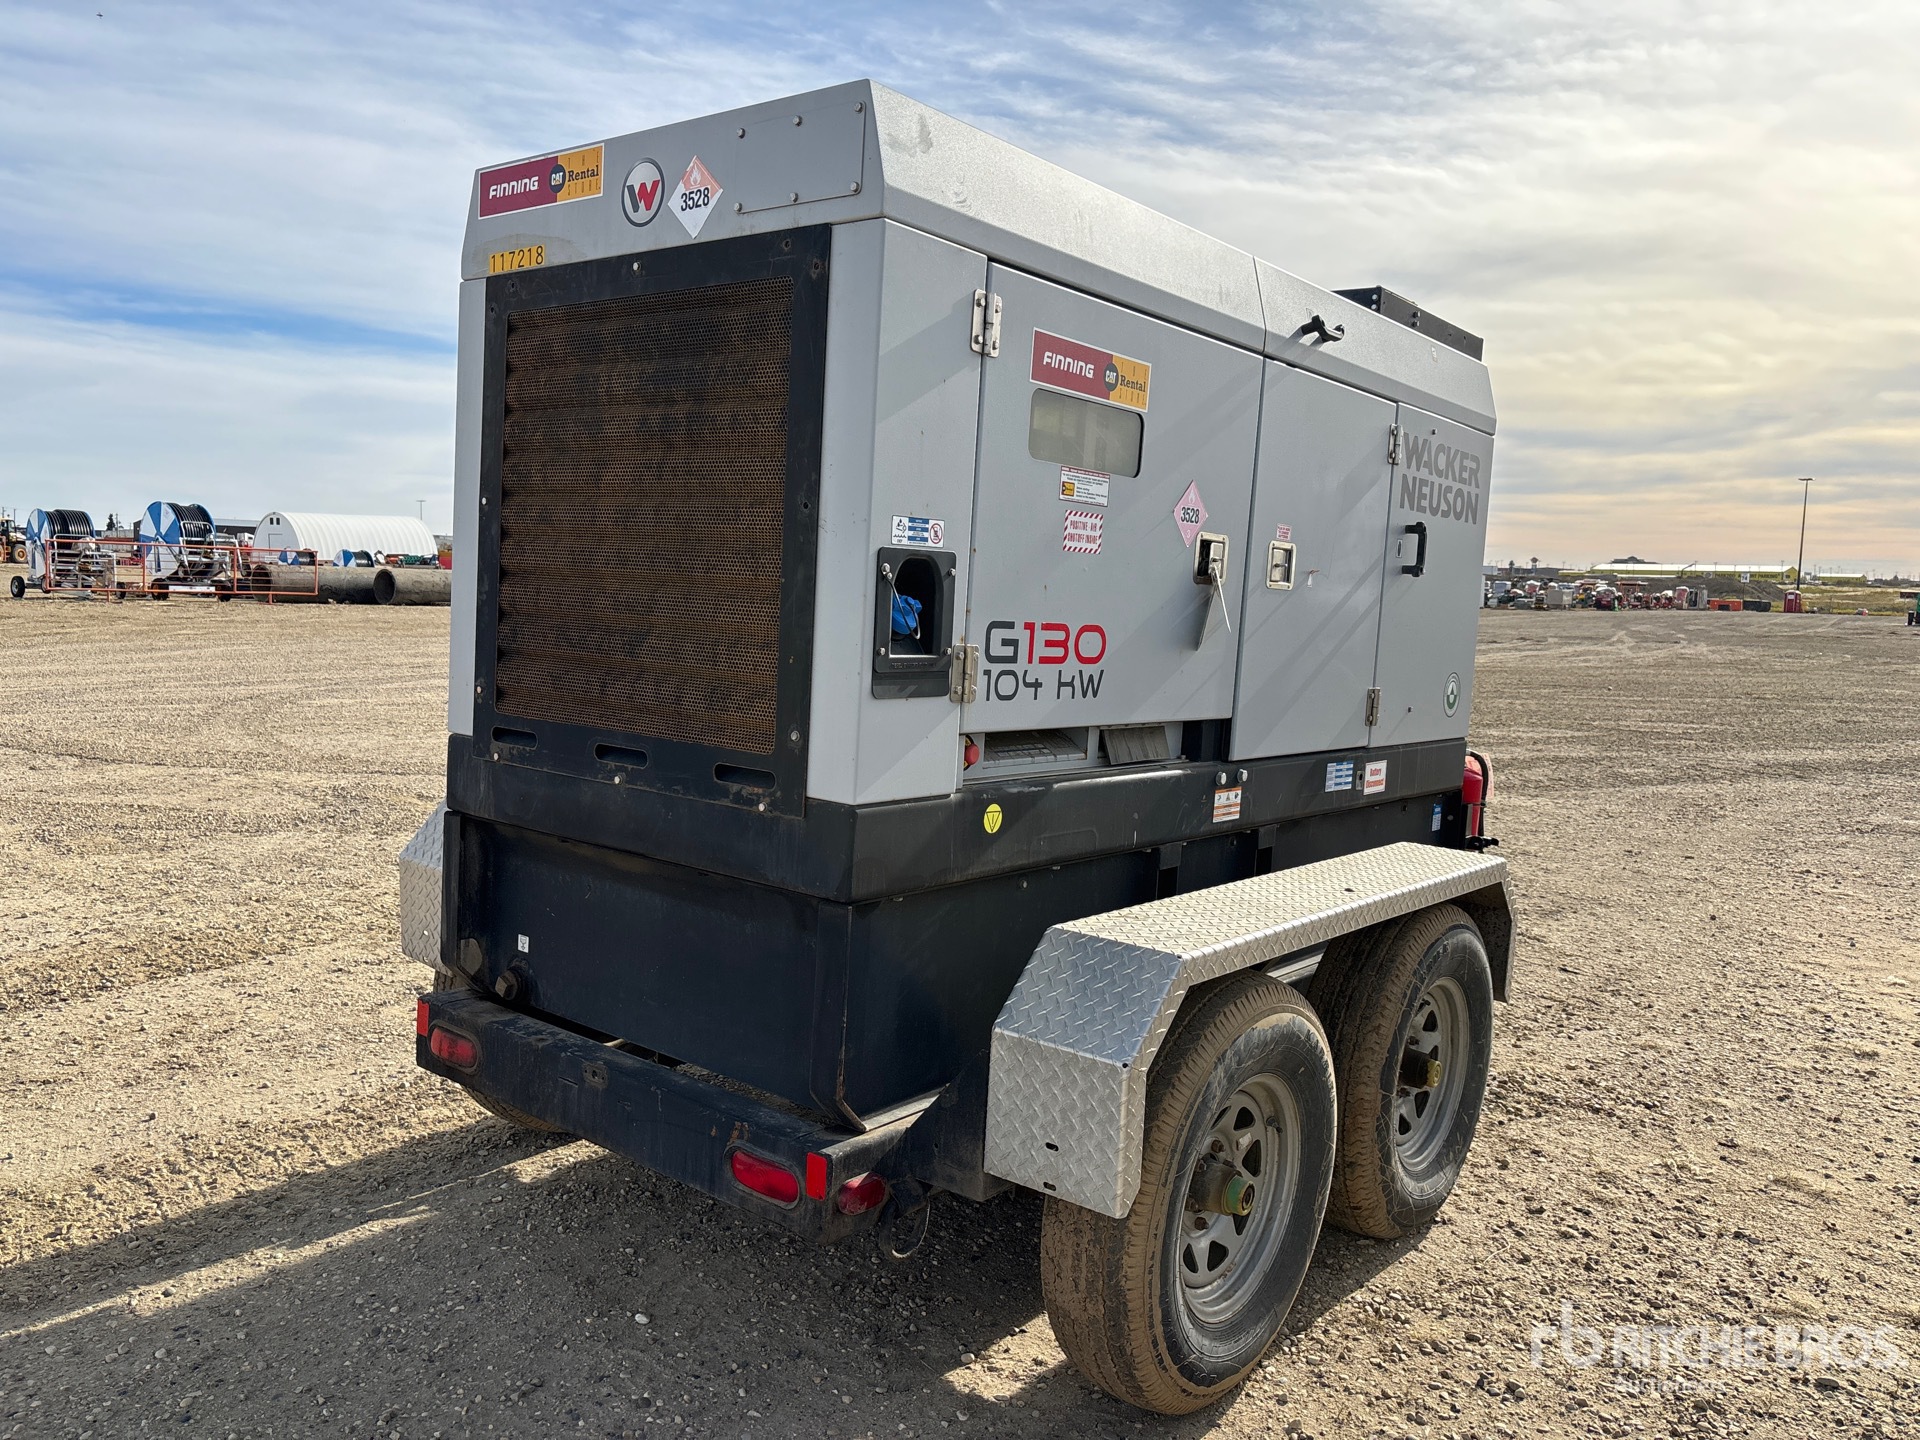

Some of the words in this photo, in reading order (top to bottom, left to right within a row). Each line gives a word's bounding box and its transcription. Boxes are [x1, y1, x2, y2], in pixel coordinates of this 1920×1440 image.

[489, 175, 539, 200] FINNING
[551, 172, 564, 186] CAT
[567, 165, 599, 183] Rental
[681, 187, 710, 212] 3528
[490, 245, 545, 273] 117218
[1043, 351, 1095, 379] FINNING
[1105, 370, 1117, 384] CAT
[1119, 375, 1146, 392] Rental
[1403, 431, 1481, 489] WACKER
[1180, 506, 1200, 524] 3528
[1399, 473, 1480, 525] NEUSON
[1186, 529, 1191, 538] 3
[984, 620, 1107, 664] G130
[983, 669, 1043, 702] 104
